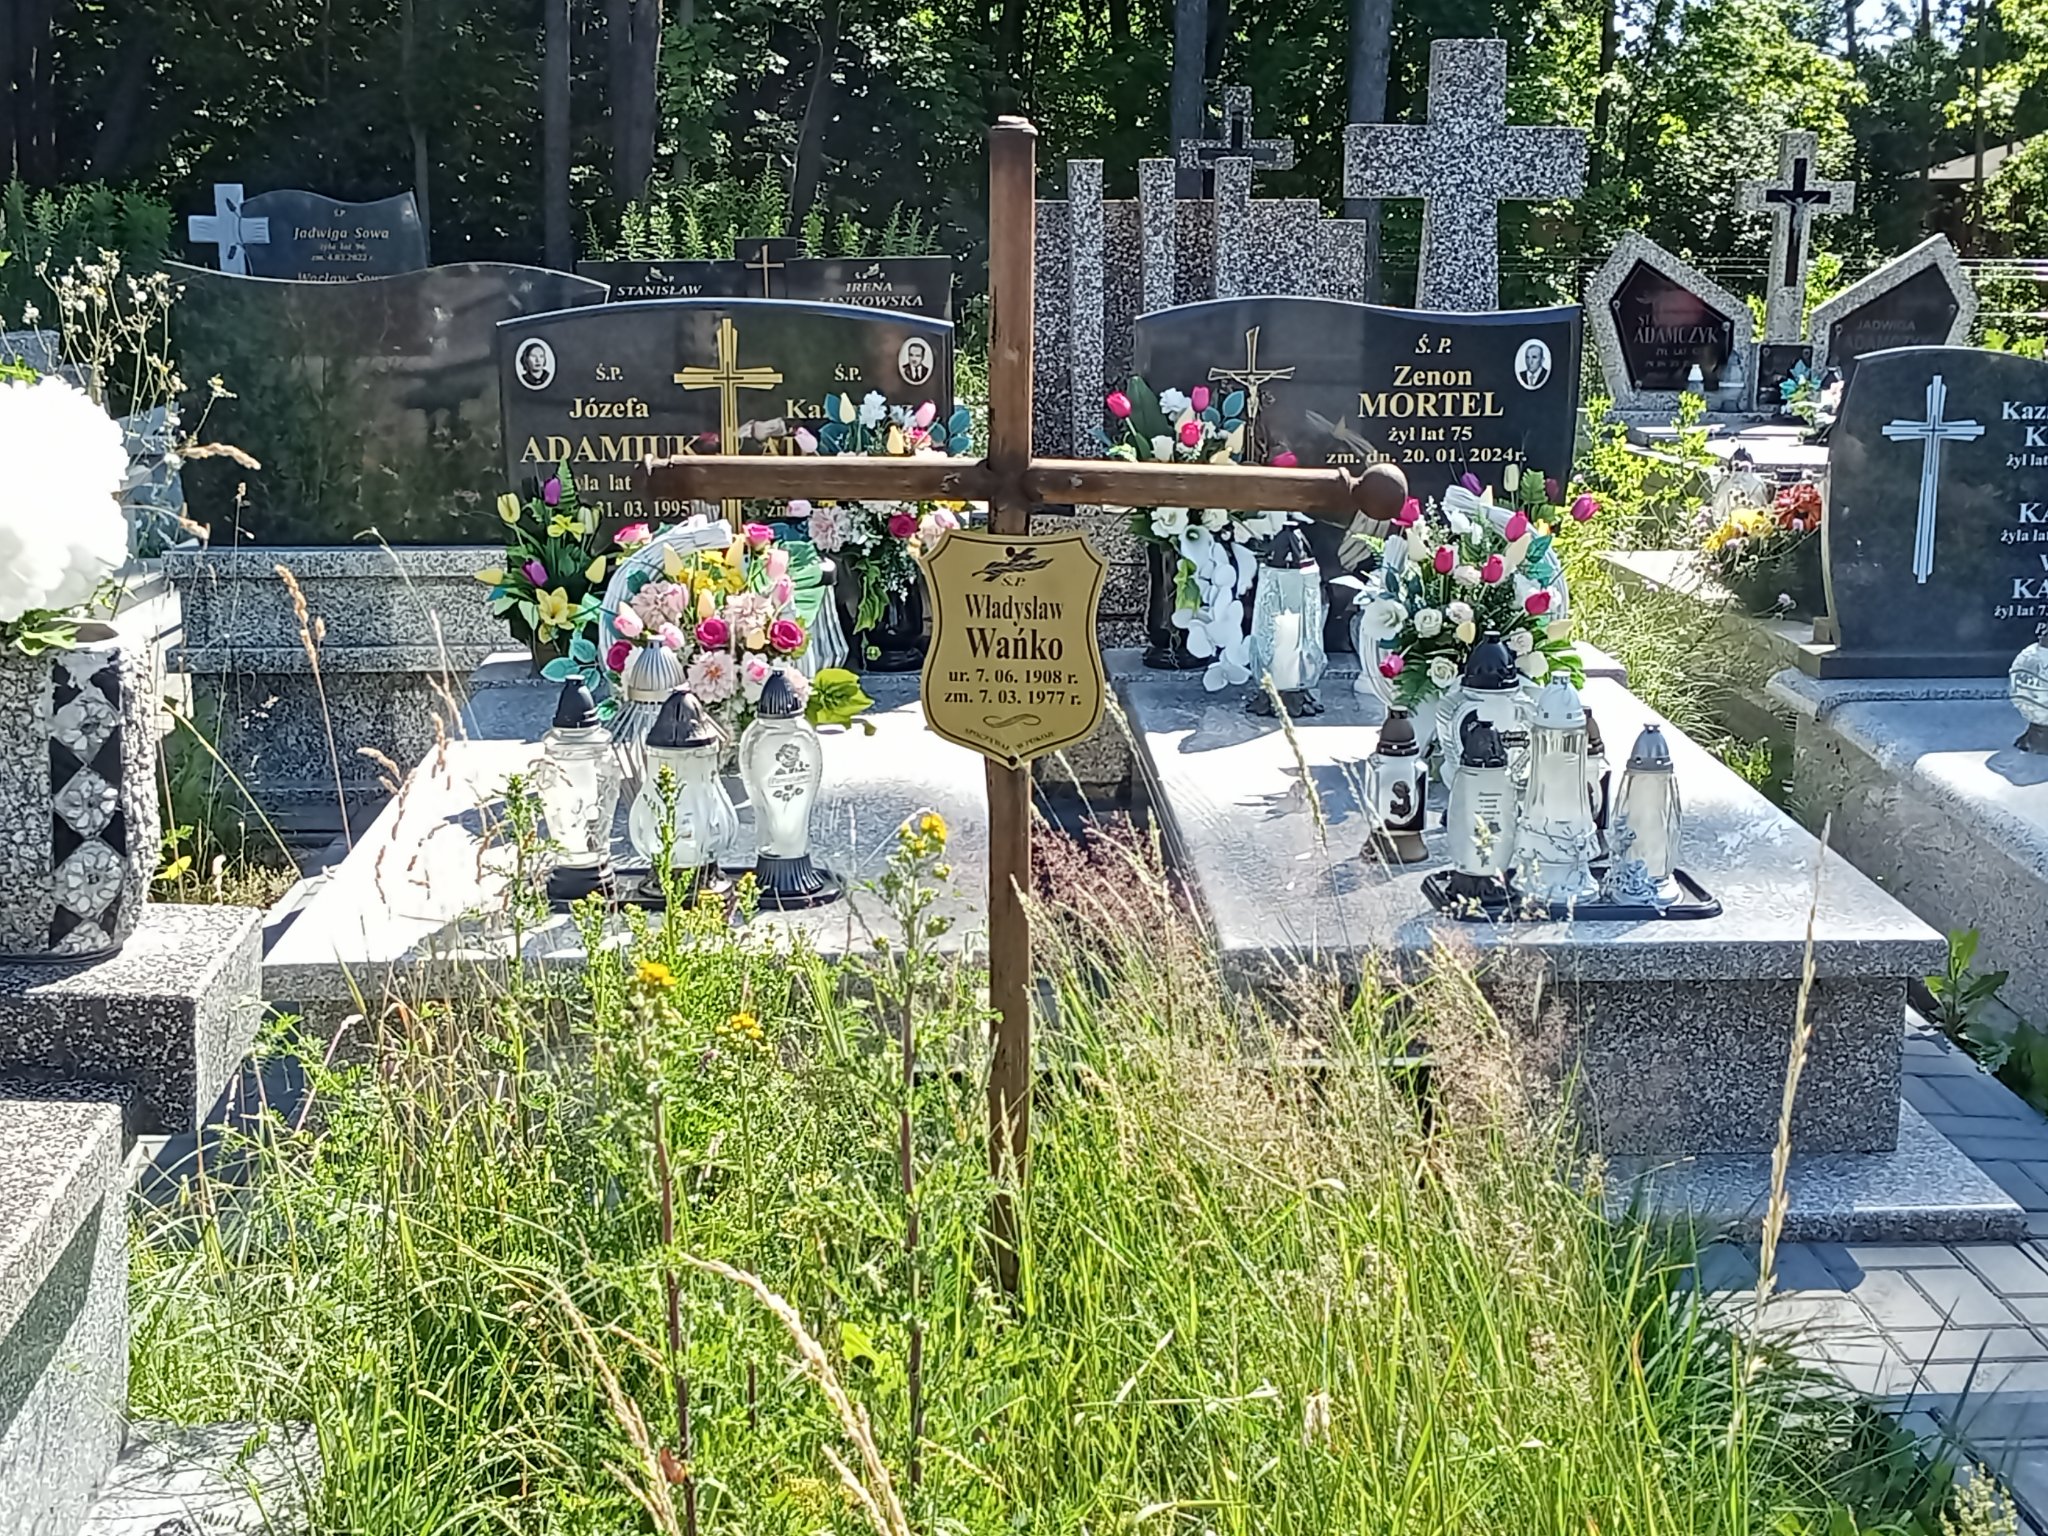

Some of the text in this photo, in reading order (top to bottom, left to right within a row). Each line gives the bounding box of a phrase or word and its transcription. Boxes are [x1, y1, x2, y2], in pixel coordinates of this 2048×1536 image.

[293, 227, 390, 241] Jadwiga Sowa
[846, 282, 893, 293] IRENA
[595, 363, 624, 381] Ś.P.
[834, 363, 862, 381] Ś.P.
[1392, 365, 1472, 387] Zenon
[569, 397, 650, 418] Józefa
[1357, 391, 1504, 418] MORTEL
[1420, 426, 1445, 441] lat
[1450, 426, 1473, 441] 75
[520, 436, 701, 463] ADAMIUK
[1326, 451, 1361, 464] zm.
[1366, 450, 1397, 464] dn.
[1402, 448, 1431, 463] 20.
[1436, 448, 1464, 463] 01.
[609, 473, 632, 491] lat
[624, 500, 648, 518] 03.
[654, 500, 690, 518] 1995
[965, 593, 1064, 627] Władysław
[2016, 605, 2035, 616] lat
[2038, 604, 2048, 616] 7
[966, 627, 1063, 660] Wańko
[949, 668, 1079, 684] ur. 7. 06. 1908 r.
[944, 689, 1082, 705] zm. 7. 03. 1977 r.
